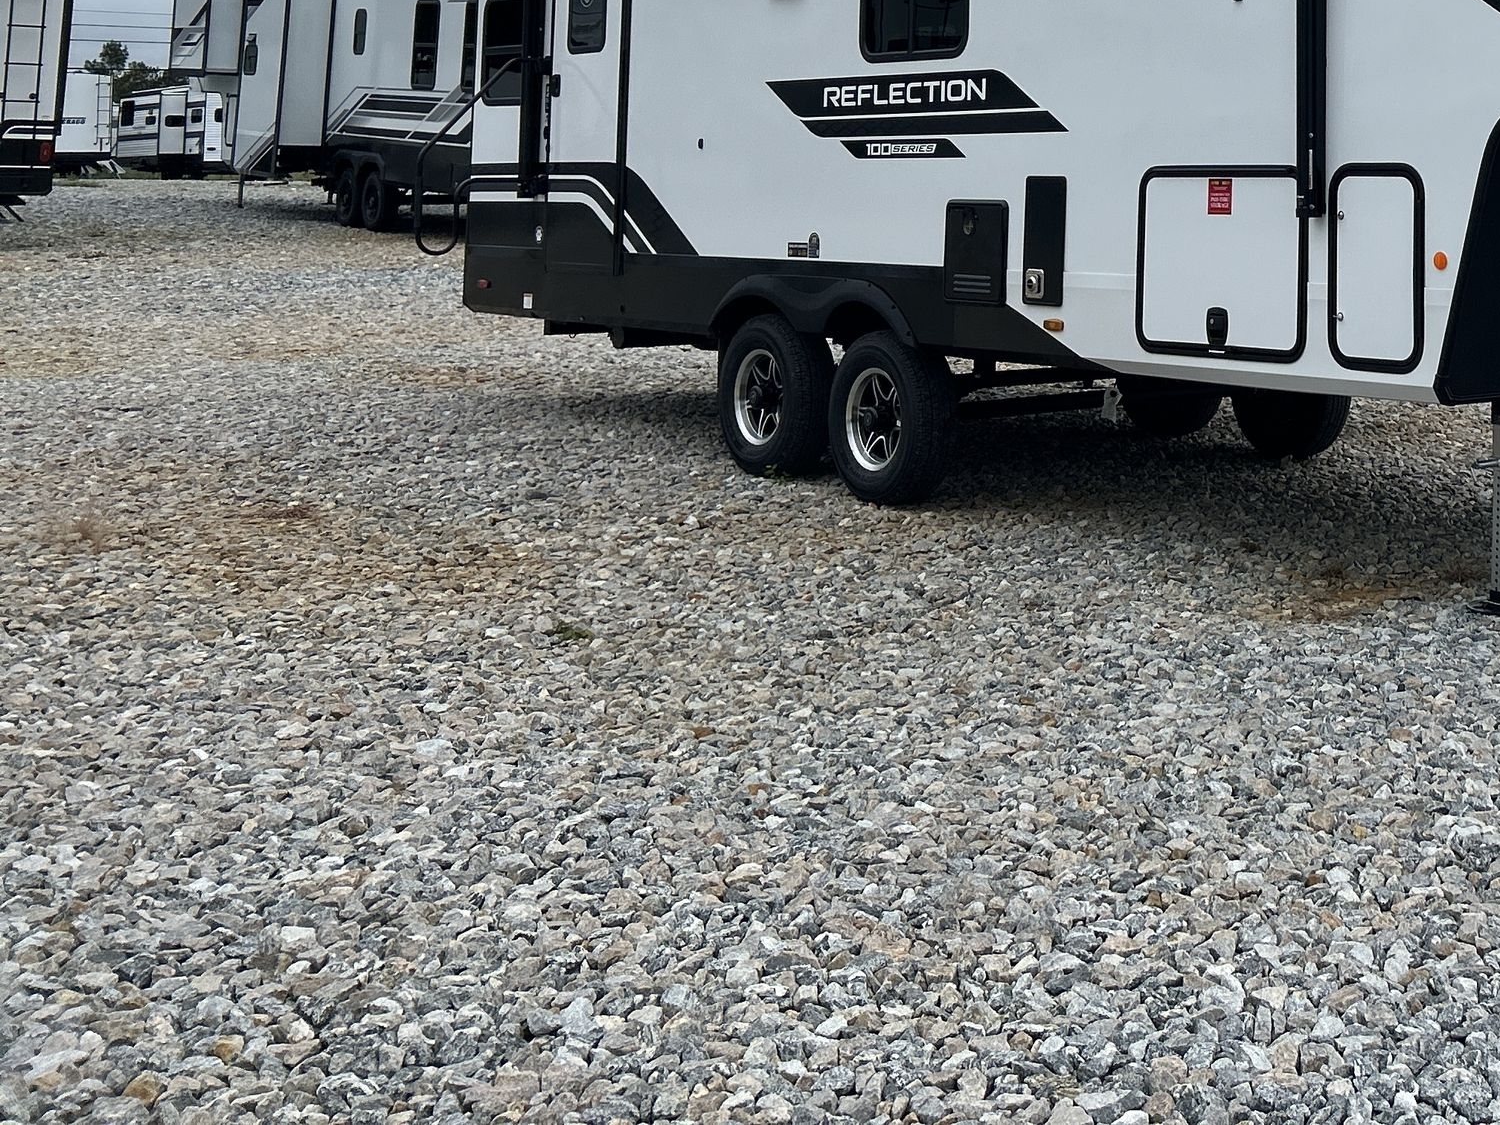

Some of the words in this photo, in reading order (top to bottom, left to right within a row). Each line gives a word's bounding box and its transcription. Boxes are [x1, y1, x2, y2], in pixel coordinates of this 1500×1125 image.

[823, 78, 987, 107] REFLECTION
[866, 143, 891, 156] 100
[892, 144, 936, 154] SERIES
